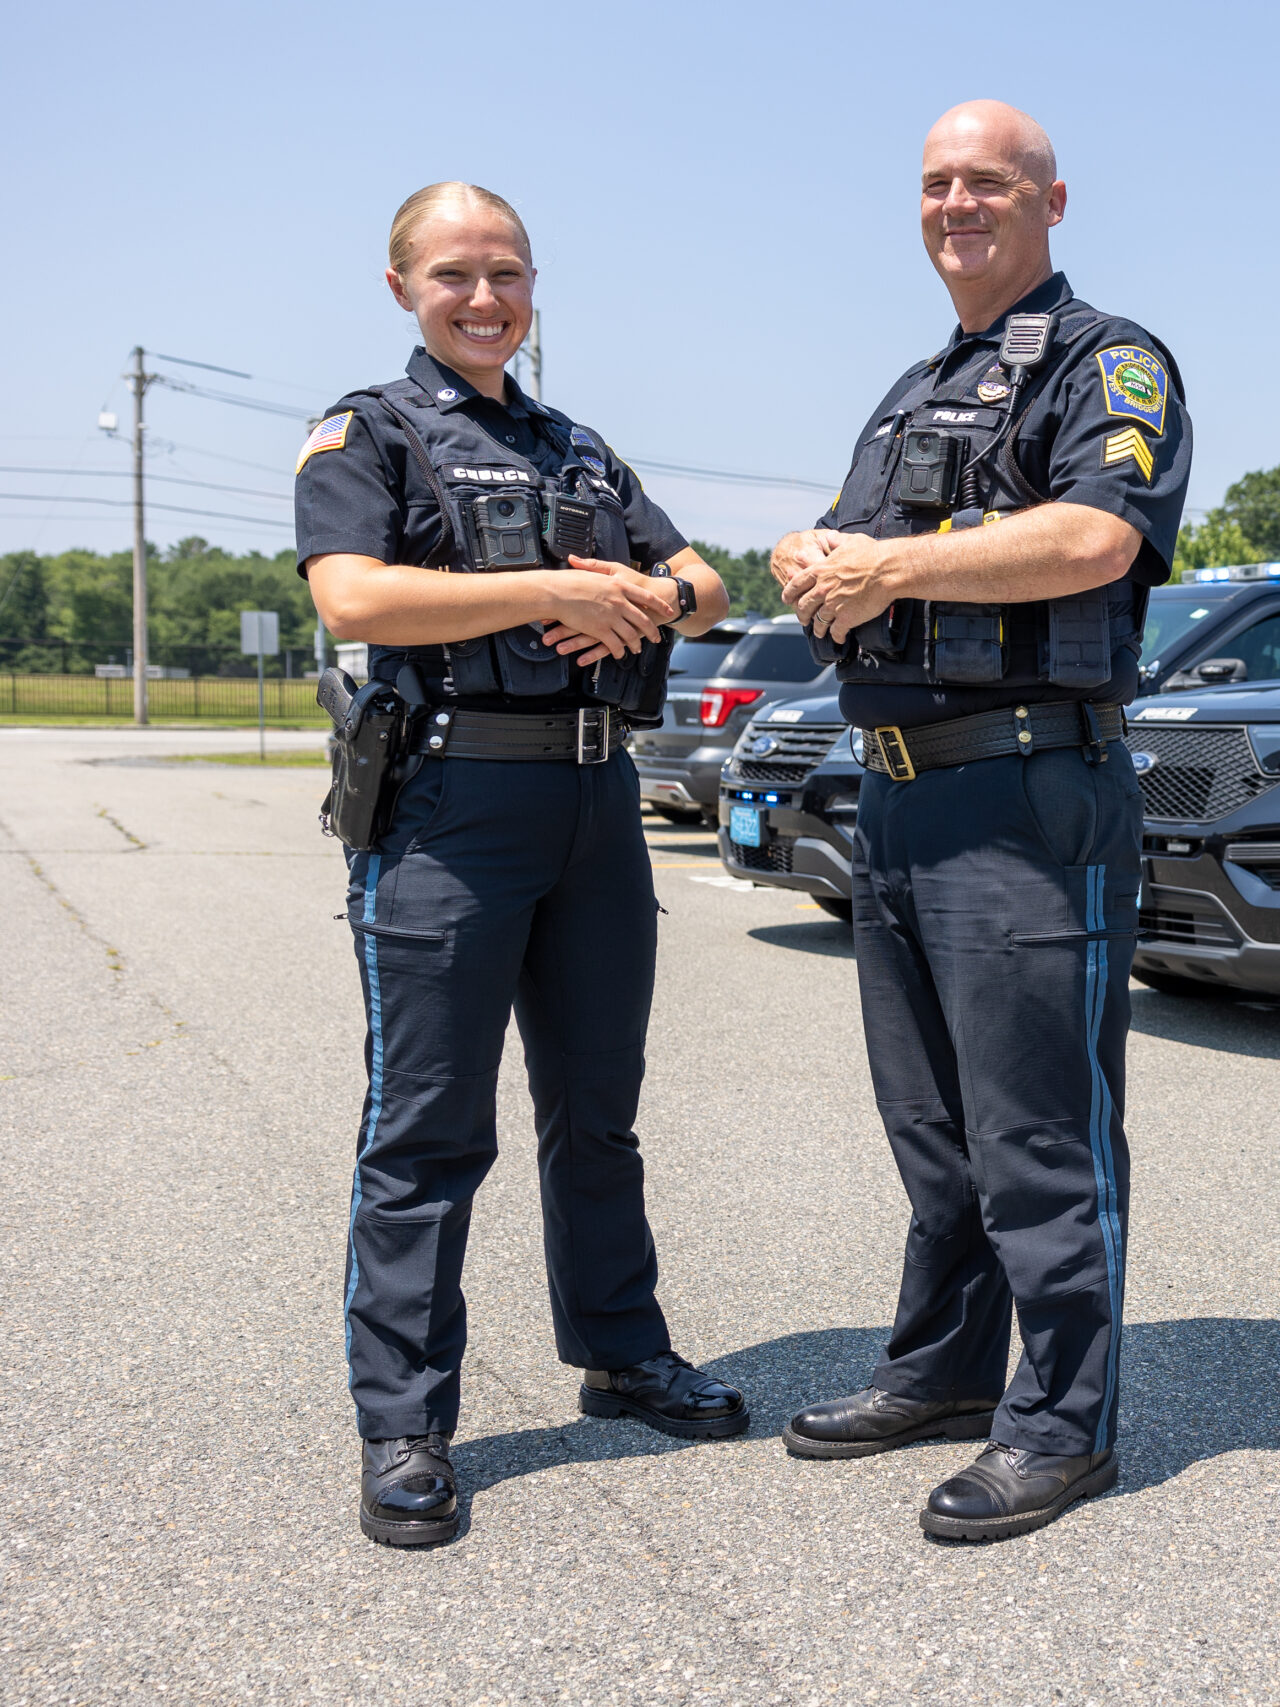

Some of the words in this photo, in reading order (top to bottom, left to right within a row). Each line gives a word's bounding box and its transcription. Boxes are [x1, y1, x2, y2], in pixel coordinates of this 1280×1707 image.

[1109, 350, 1159, 375] POLICE
[1107, 375, 1122, 396] WEST
[933, 410, 978, 422] POLICE
[453, 467, 530, 482] CHURCH
